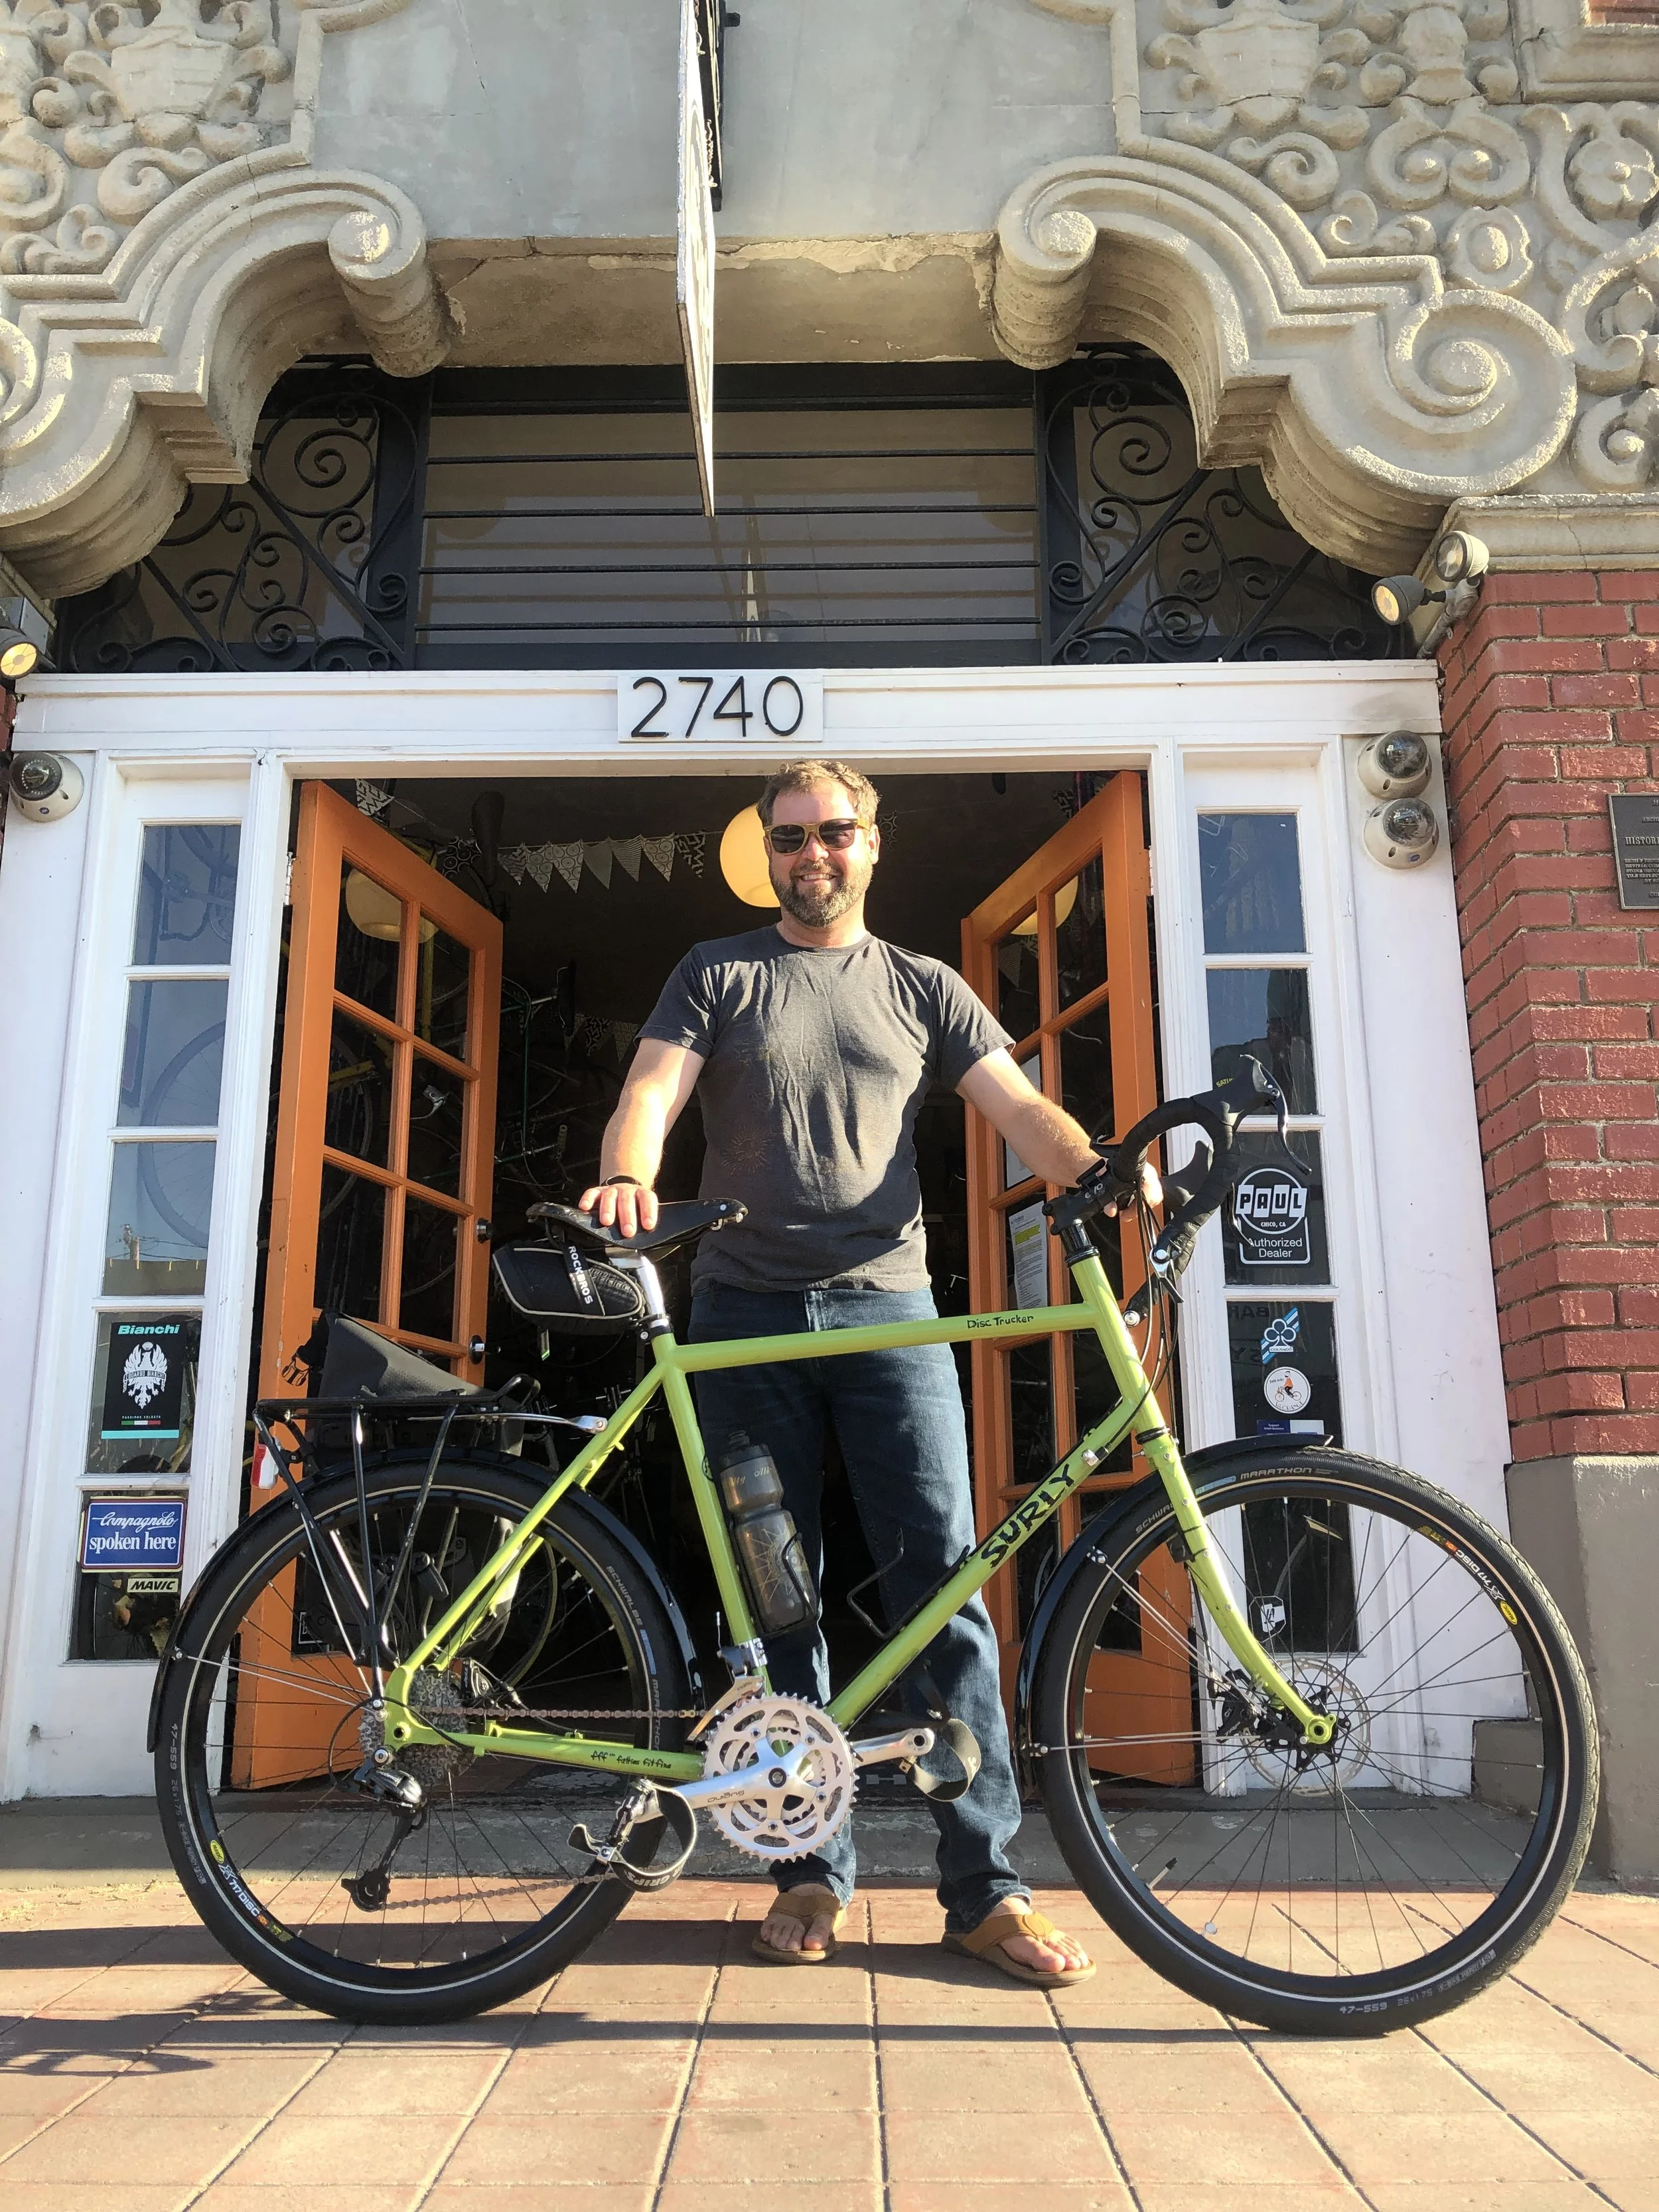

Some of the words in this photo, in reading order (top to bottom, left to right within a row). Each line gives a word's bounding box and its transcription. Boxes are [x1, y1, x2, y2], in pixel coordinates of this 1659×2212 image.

[631, 675, 804, 738] 2740
[1238, 1191, 1304, 1211] PAUL
[1248, 1237, 1303, 1247] Authorized
[1258, 1248, 1293, 1258] Dealer
[568, 1246, 594, 1305] ROCKBROS
[118, 1325, 180, 1335] Bianchi
[967, 1318, 992, 1329] Disc
[992, 1315, 1035, 1326] Trucker
[1240, 1467, 1313, 1481] MARATHON
[92, 1511, 179, 1533] Campagnolo
[981, 1463, 1075, 1568] SURLY
[1135, 1503, 1174, 1534] SCHWA
[89, 1531, 140, 1554] spoken
[143, 1531, 177, 1550] here
[1455, 1549, 1480, 1574] DISC
[130, 1580, 176, 1591] MAVIC
[607, 1566, 643, 1626] SCHWALBE
[707, 1790, 745, 1803] sugino
[238, 1890, 261, 1917] DISC
[1340, 2002, 1388, 2014] 47-559
